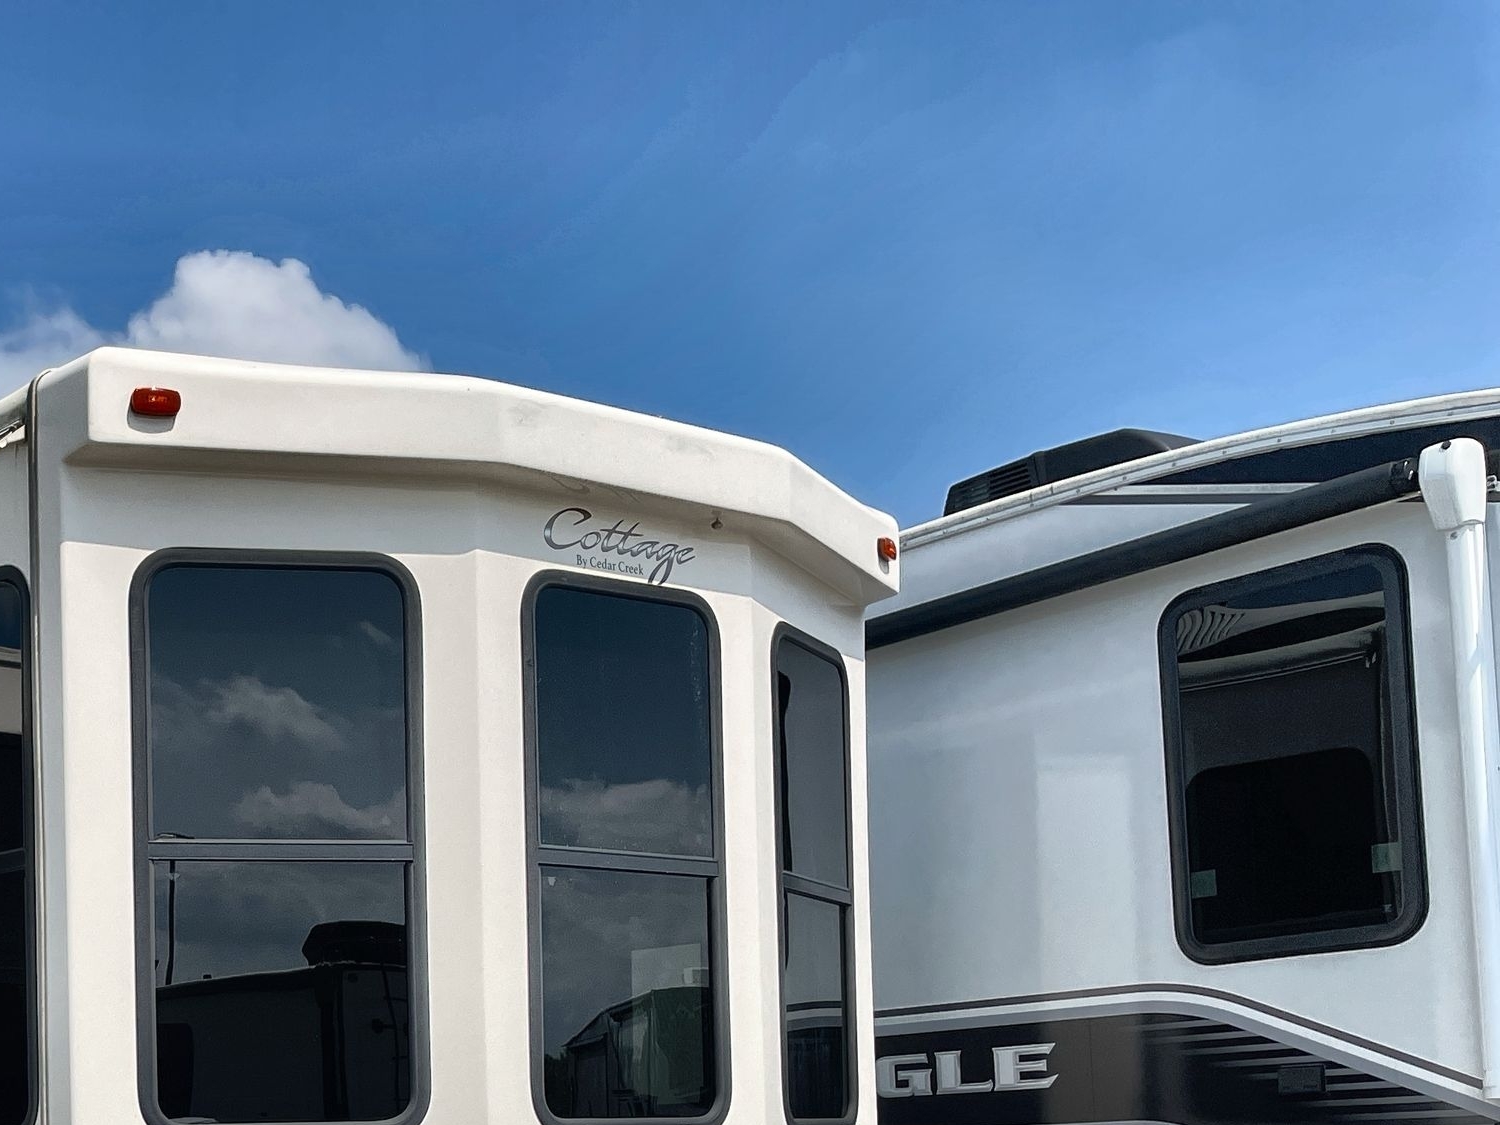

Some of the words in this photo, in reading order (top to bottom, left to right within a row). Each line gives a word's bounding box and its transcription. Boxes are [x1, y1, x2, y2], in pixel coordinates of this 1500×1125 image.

[543, 507, 696, 585] Cottage
[576, 554, 588, 569] By
[589, 556, 617, 571] Cedar
[618, 561, 644, 576] Creek
[875, 1042, 1059, 1098] GLE
